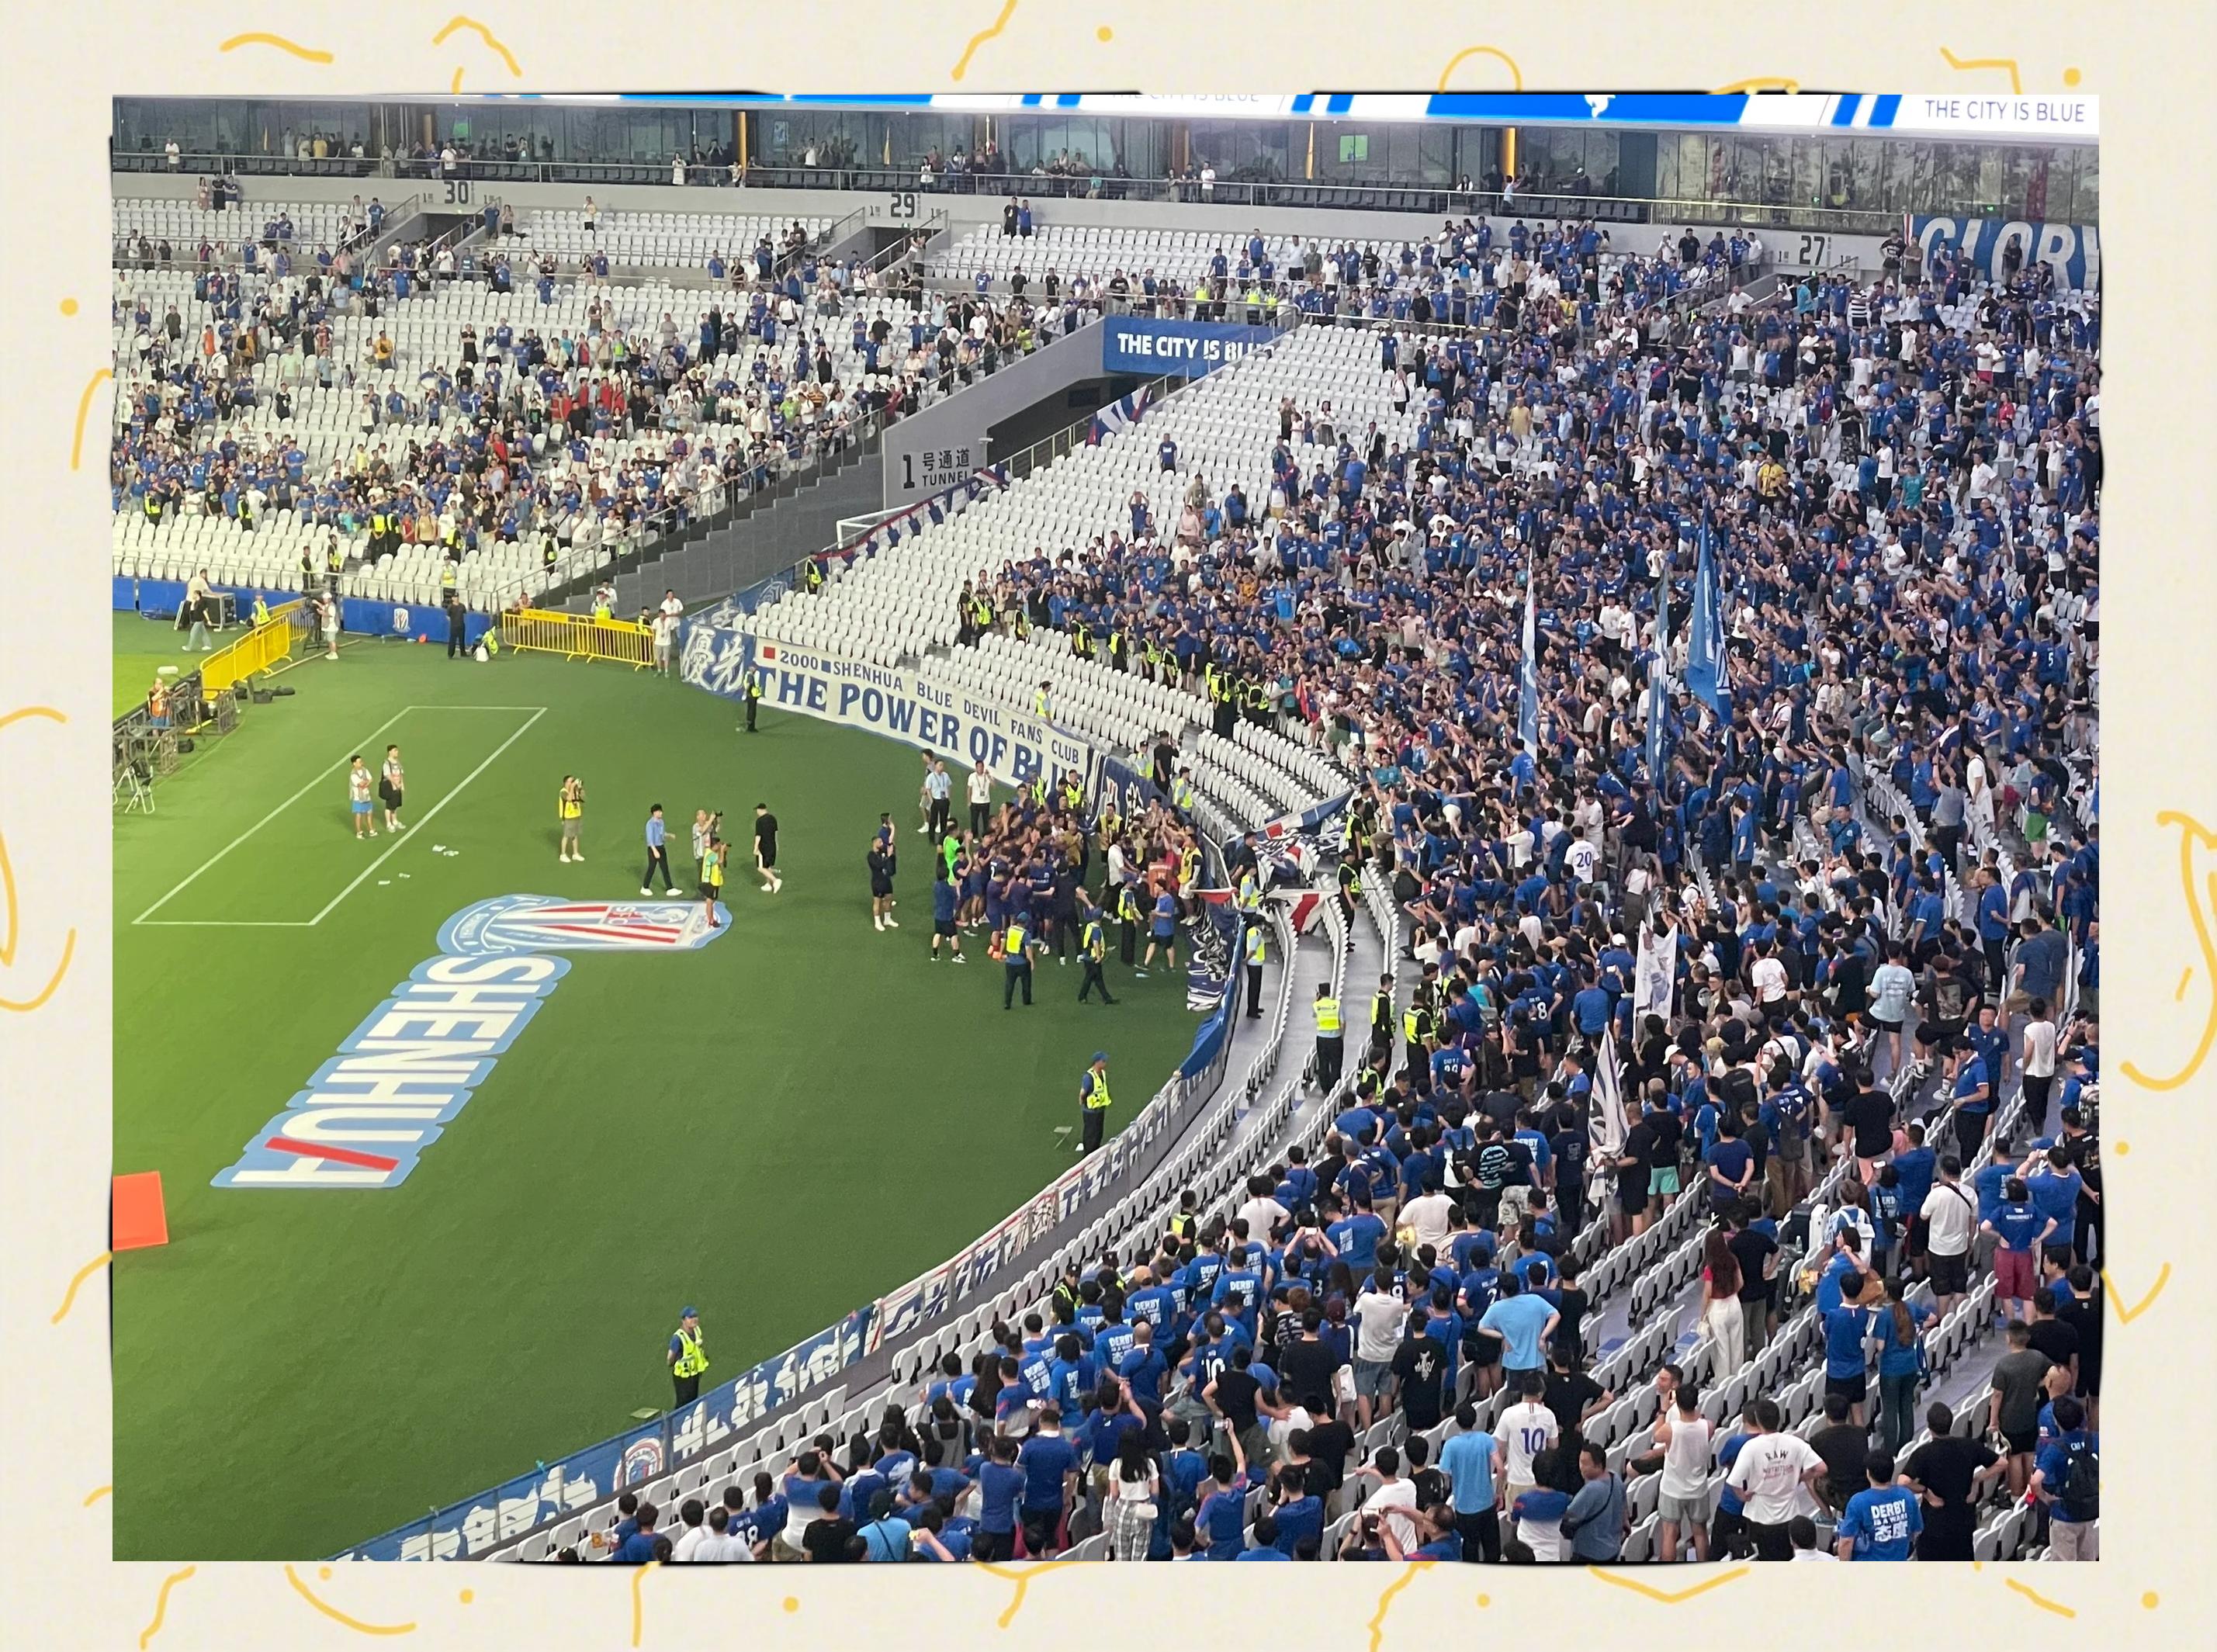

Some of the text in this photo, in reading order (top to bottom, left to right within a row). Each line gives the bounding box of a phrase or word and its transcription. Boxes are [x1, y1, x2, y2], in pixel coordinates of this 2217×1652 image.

[1925, 99, 2085, 123] THE CITY IS BLUE
[443, 180, 469, 204] 30
[890, 192, 915, 218] 29
[1799, 235, 1825, 265] 27
[1117, 332, 1152, 355] THE
[1155, 336, 1199, 359] CITY
[1203, 339, 1221, 361] IS
[902, 448, 970, 490] 1 号通道
[754, 665, 828, 712] THE
[838, 683, 961, 752] POWER
[969, 725, 1008, 769] OF
[780, 649, 1079, 764] 2000 SHENHUA BLUE DEVIL FANS CLUB
[1576, 850, 1592, 868] 20
[231, 956, 556, 1183] SHENHUA
[1229, 1280, 1256, 1291] DERBY
[1134, 1297, 1160, 1311] DERBY
[1520, 1427, 1545, 1454] 10
[1765, 1449, 1789, 1461] RAW
[1870, 1498, 1906, 1519] DERBY
